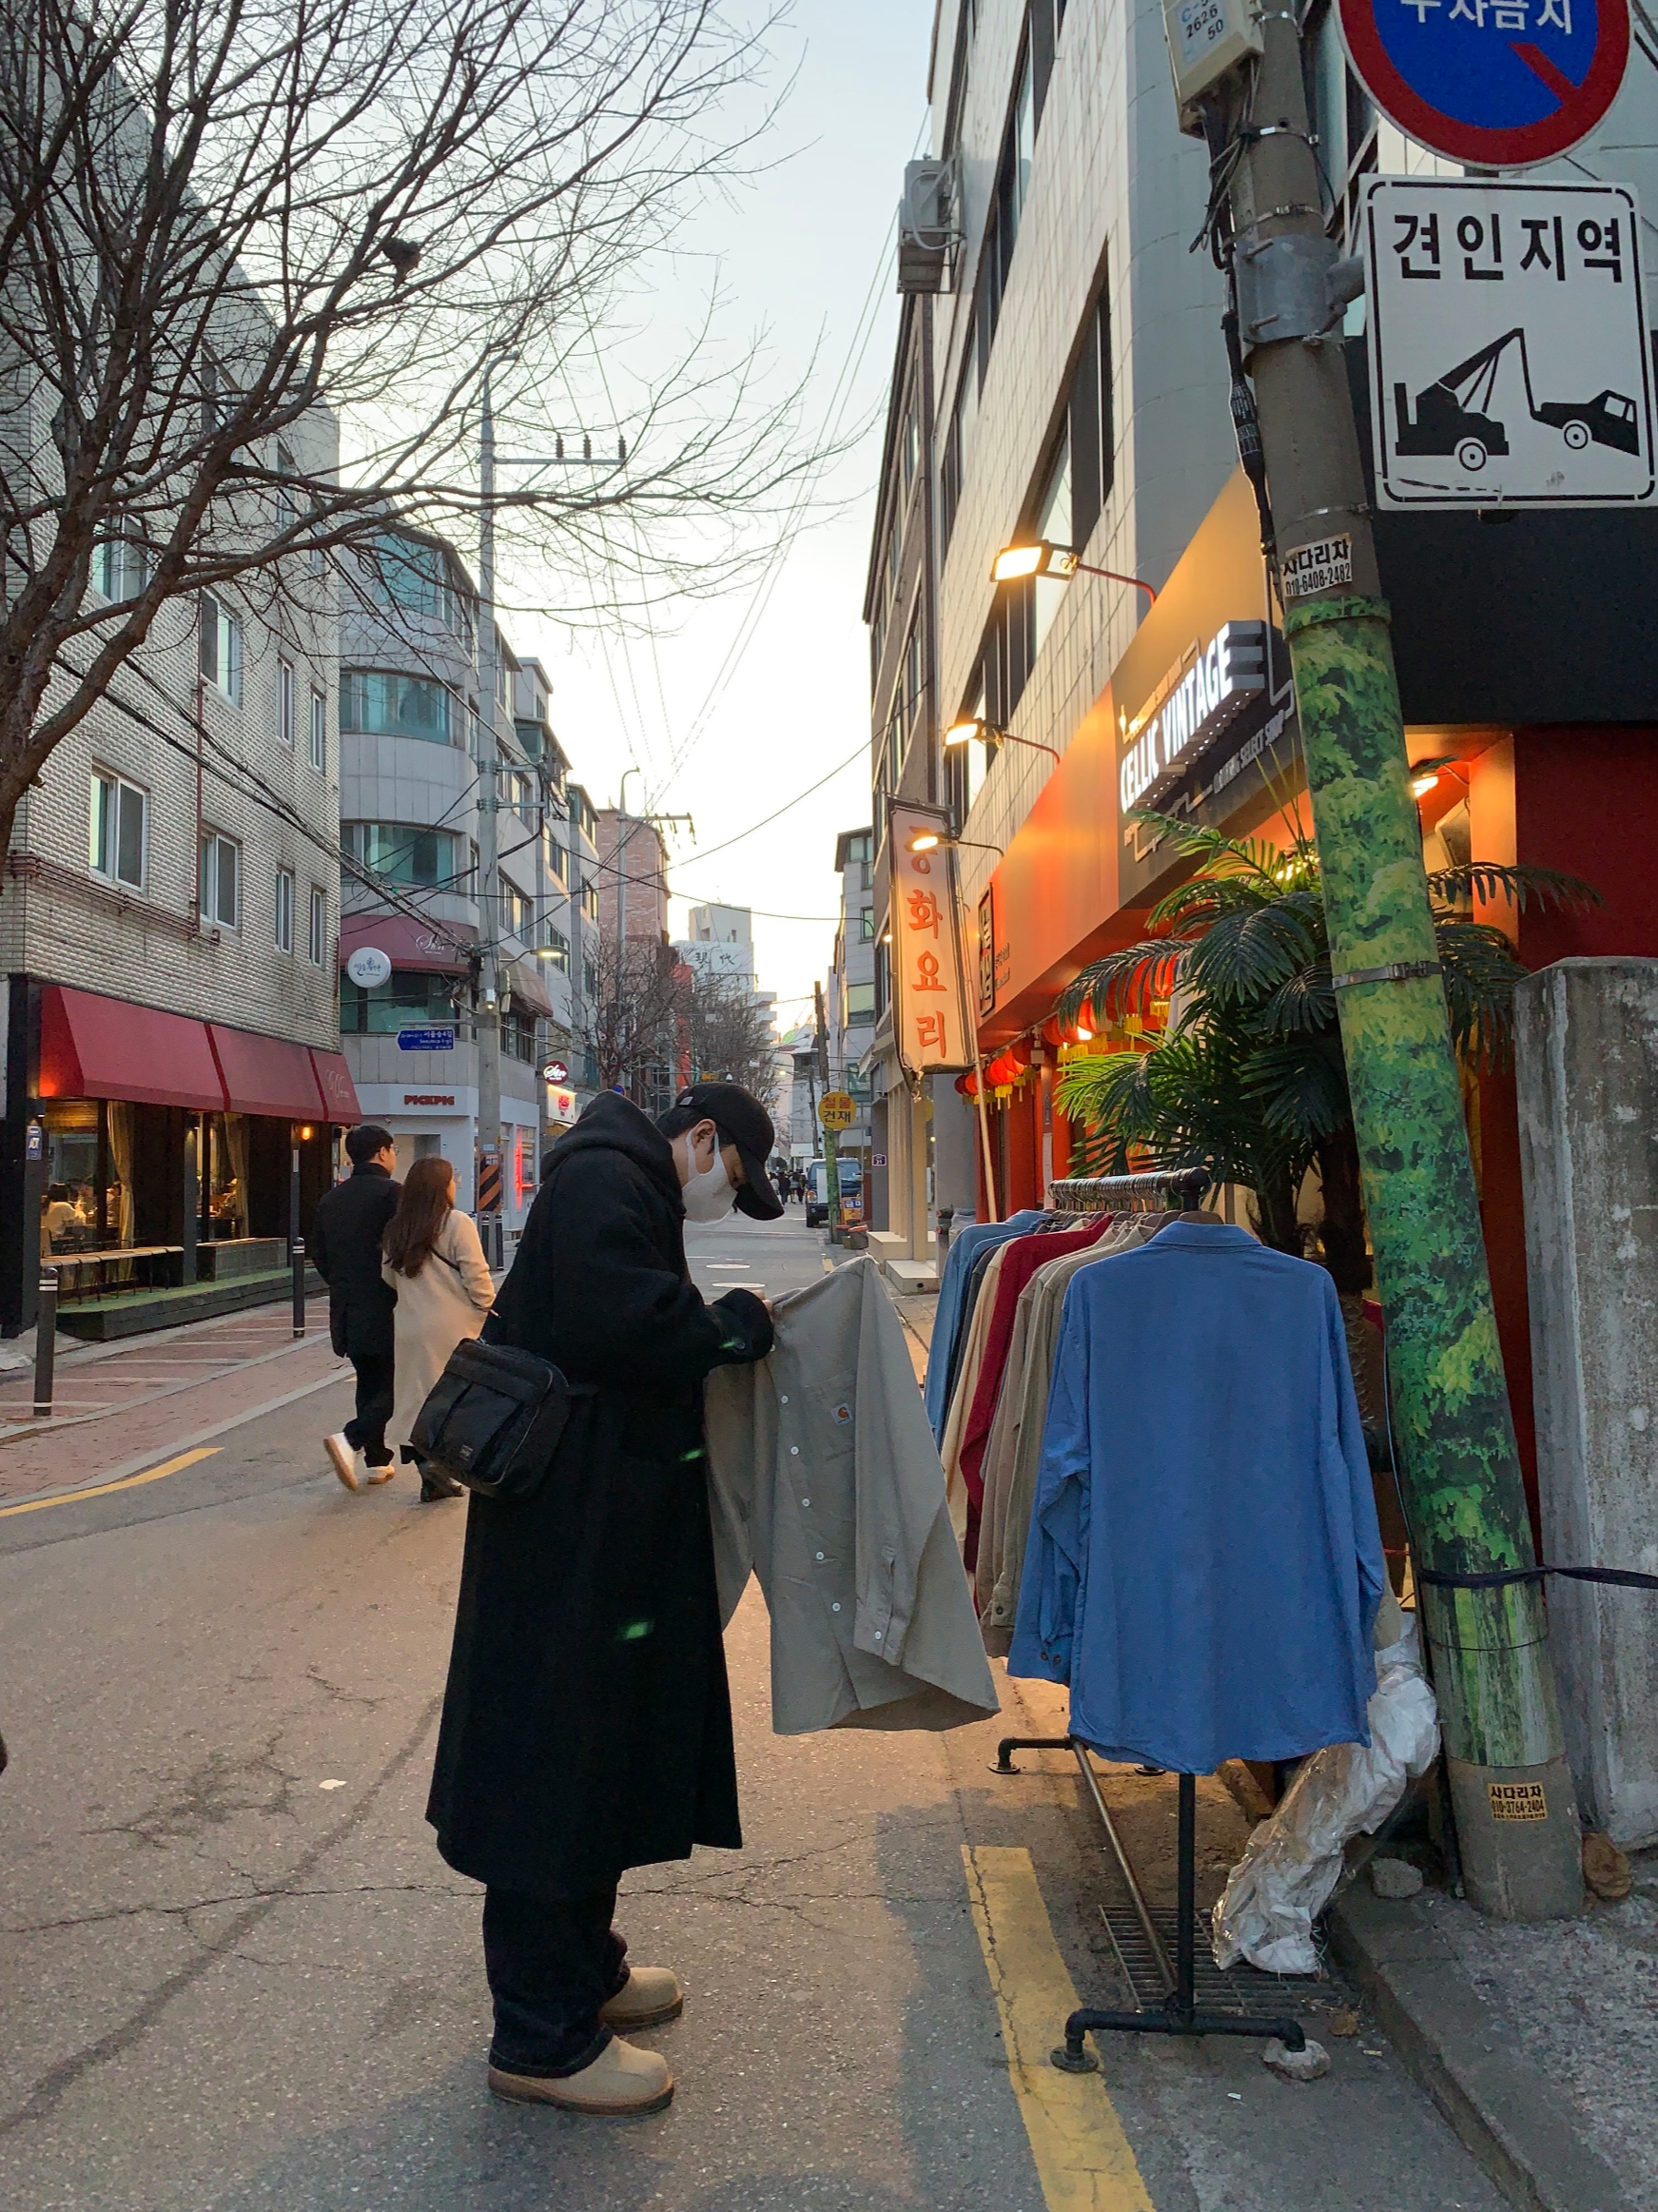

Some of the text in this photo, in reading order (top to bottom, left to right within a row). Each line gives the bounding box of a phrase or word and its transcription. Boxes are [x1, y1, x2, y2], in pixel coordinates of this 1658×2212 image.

[1207, 19, 1223, 40] 50
[1393, 212, 1623, 284] 견인지역
[1121, 717, 1160, 814] CELLIC
[1161, 621, 1234, 765] VINTAGE
[823, 1096, 851, 1109] 철물
[823, 1110, 851, 1123] 건재
[1491, 1785, 1542, 1799] 사다리차
